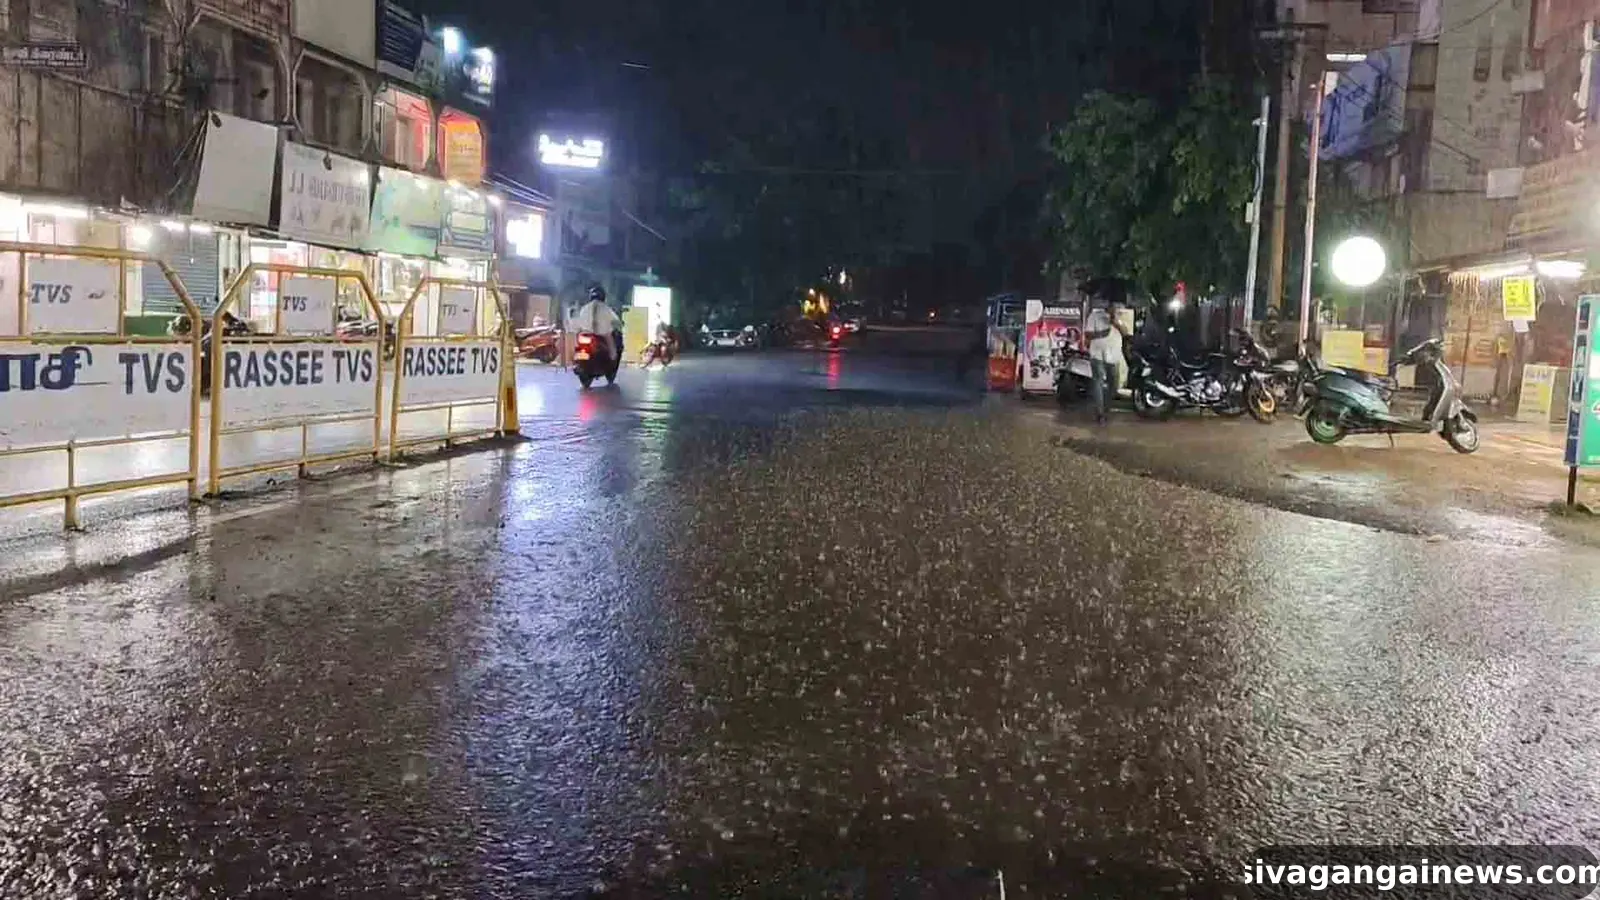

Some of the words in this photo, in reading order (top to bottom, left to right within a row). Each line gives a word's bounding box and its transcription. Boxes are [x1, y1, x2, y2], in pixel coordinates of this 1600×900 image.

[31, 283, 73, 304] TVS
[282, 295, 308, 312] TVS
[0, 345, 93, 392] ாசி
[118, 352, 186, 395] TVS
[224, 350, 324, 389] RASSEE
[332, 349, 373, 384] TVS
[402, 346, 467, 378] RASSEE
[471, 347, 499, 374] TVS
